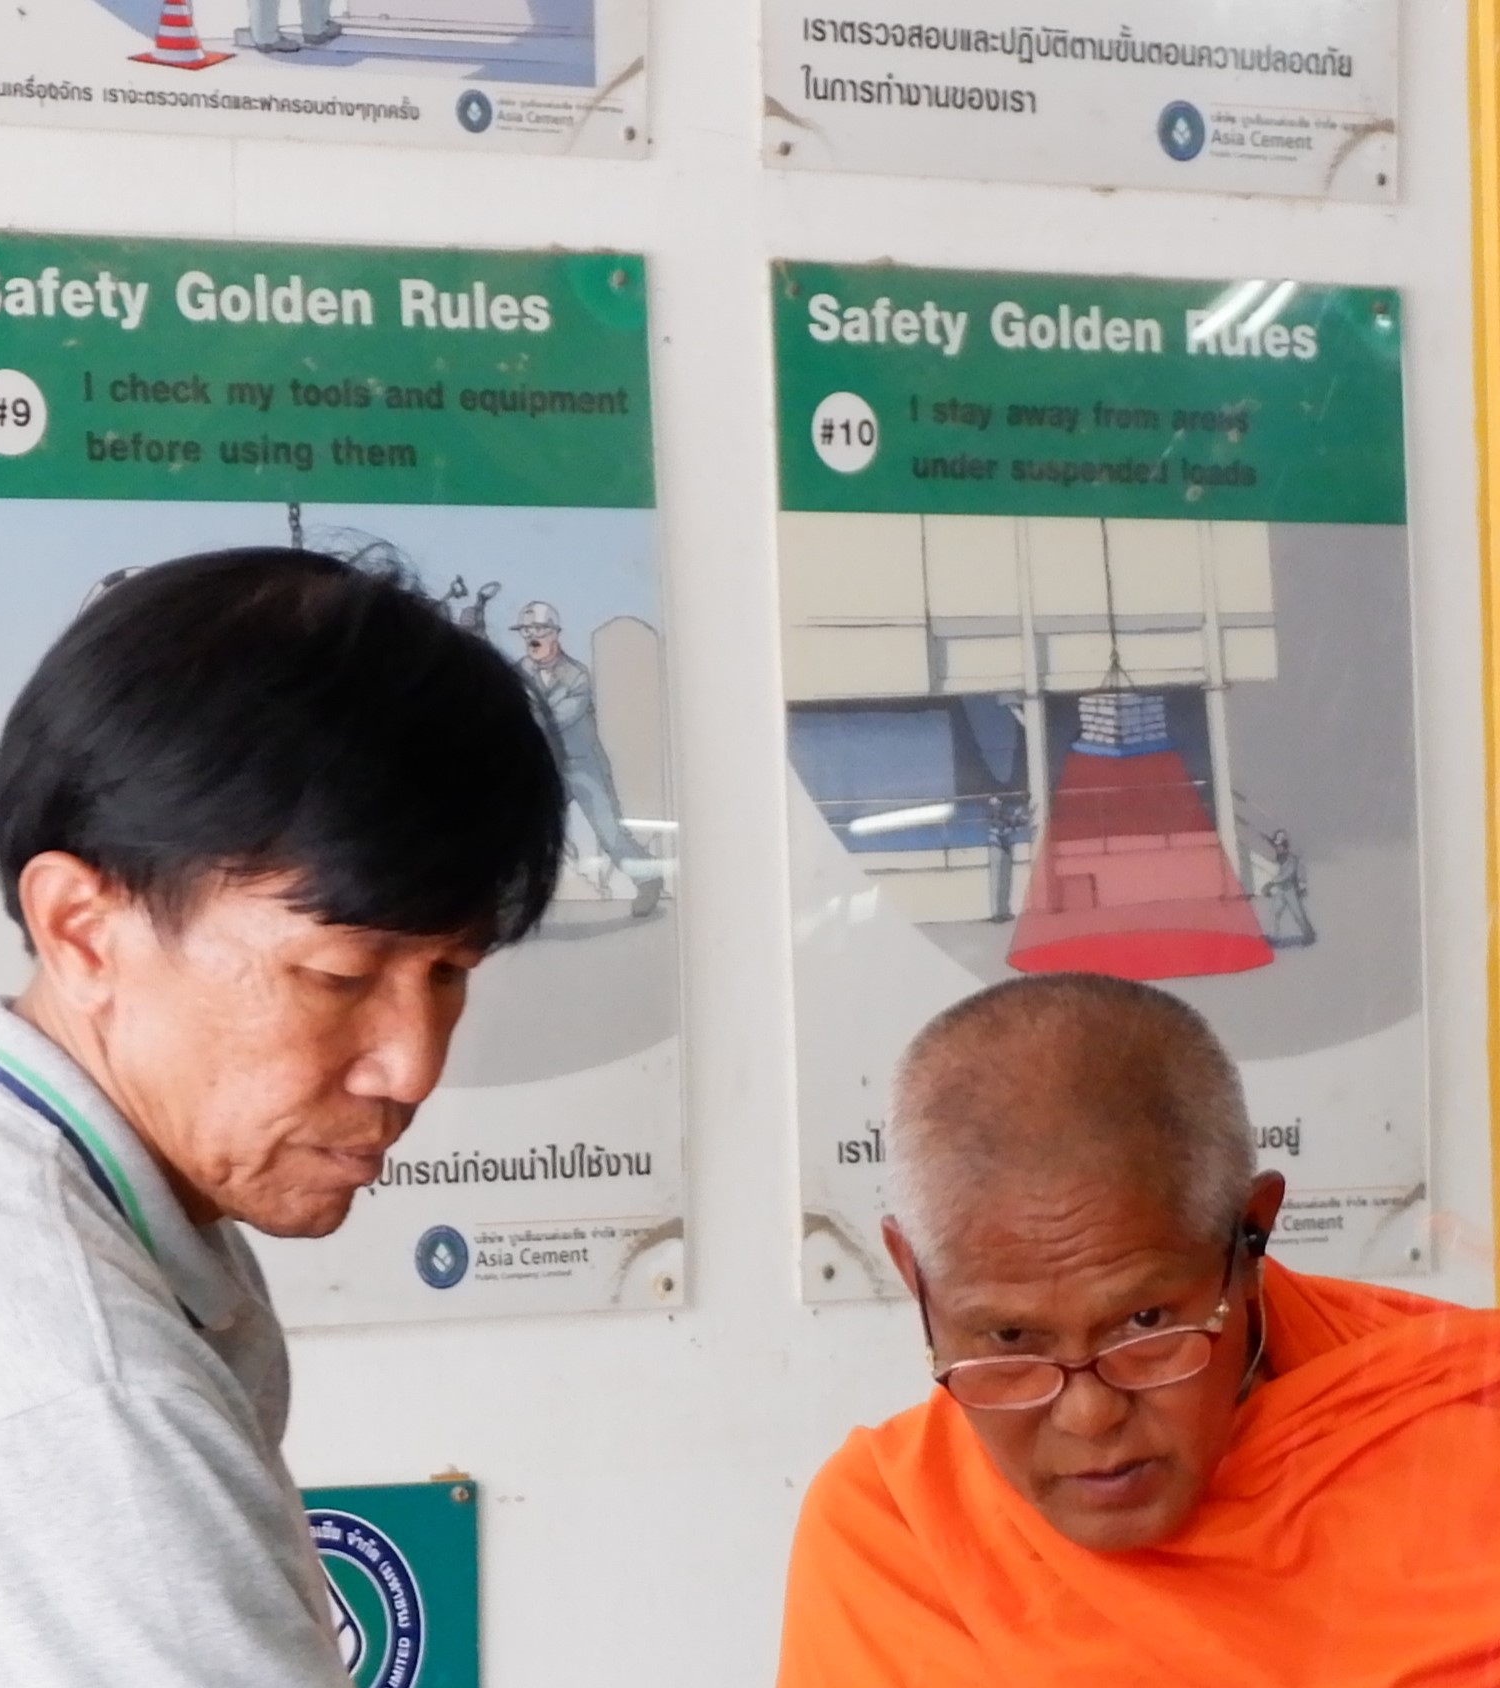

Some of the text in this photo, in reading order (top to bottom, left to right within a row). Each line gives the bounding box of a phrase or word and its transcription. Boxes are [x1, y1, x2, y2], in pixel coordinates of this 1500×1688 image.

[801, 64, 1037, 114] ในการทำงานของเรา
[1210, 129, 1314, 151] Asia Cement
[176, 272, 373, 325] Golden
[401, 279, 552, 332] Rules
[808, 294, 1318, 360] Safety Golden Rules
[83, 371, 629, 420] I check my tools and equipment
[820, 417, 876, 449] #10
[932, 398, 992, 431] stay
[1007, 403, 1079, 433] away
[1093, 400, 1160, 431] from
[87, 431, 418, 470] before using them
[912, 452, 998, 480] under
[1011, 456, 1169, 487] suspended
[367, 1143, 651, 1196] ุปกรณ์ก่อนนำไปใช้งาน
[1282, 1215, 1344, 1231] Cement
[475, 1246, 589, 1268] Asia Cement
